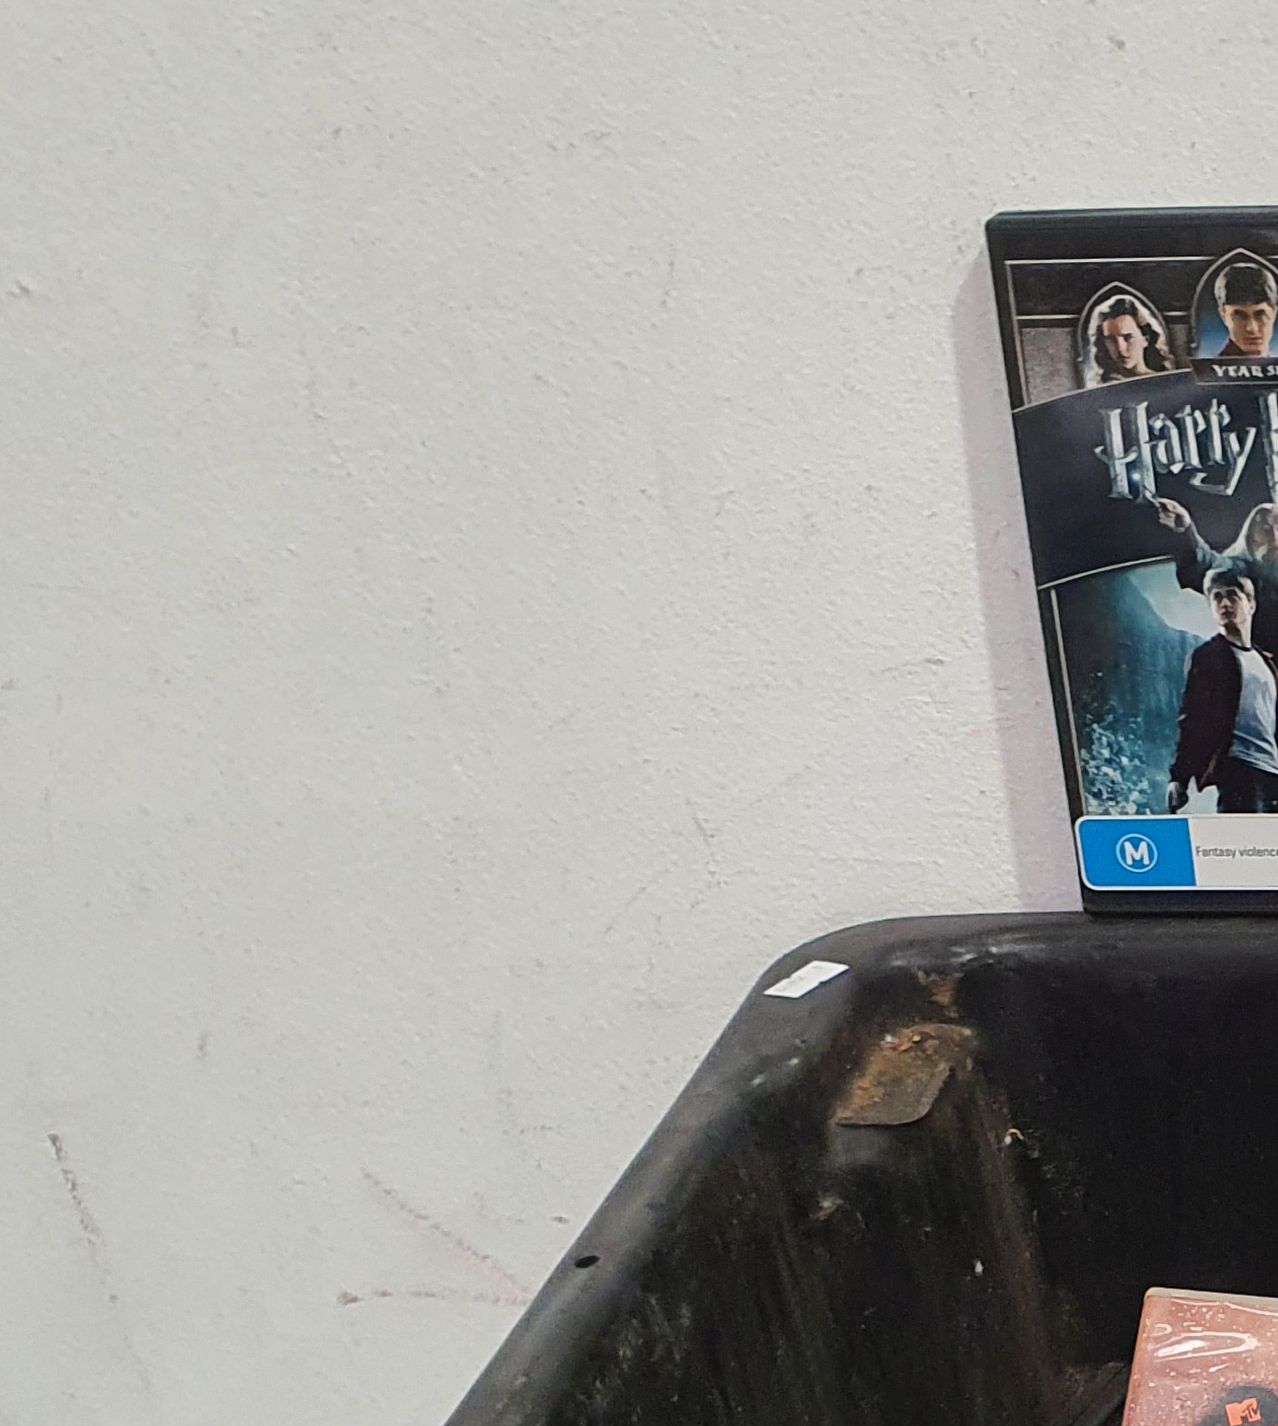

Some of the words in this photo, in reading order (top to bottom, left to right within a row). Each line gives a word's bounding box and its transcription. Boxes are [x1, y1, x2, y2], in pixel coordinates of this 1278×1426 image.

[1211, 364, 1263, 378] YEAR
[1094, 398, 1257, 499] Harry
[1123, 840, 1150, 866] M
[1195, 846, 1237, 859] Fantasy
